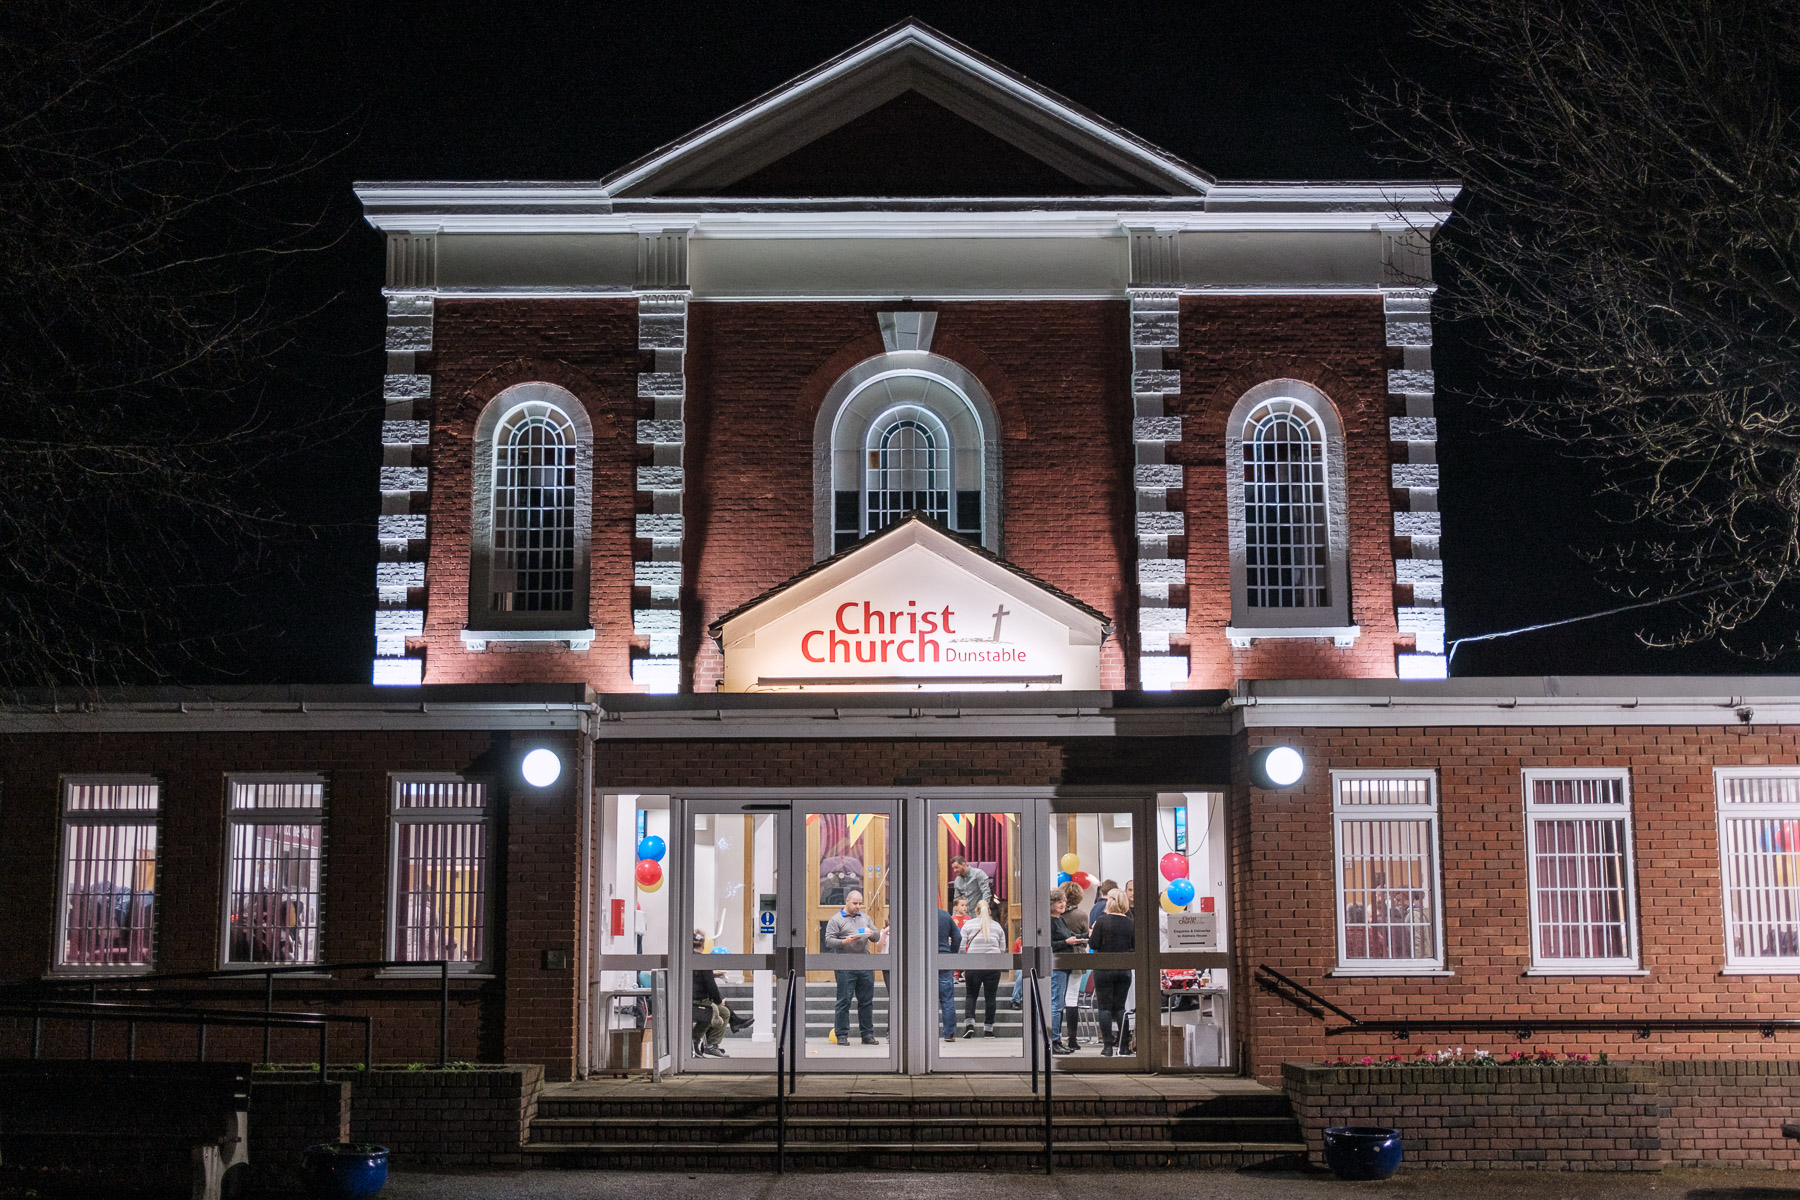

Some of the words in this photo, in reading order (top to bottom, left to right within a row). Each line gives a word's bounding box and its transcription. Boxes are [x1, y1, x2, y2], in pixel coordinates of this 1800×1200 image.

[835, 600, 956, 634] Christ
[801, 629, 940, 663] Church
[945, 647, 1027, 662] Dunstable
